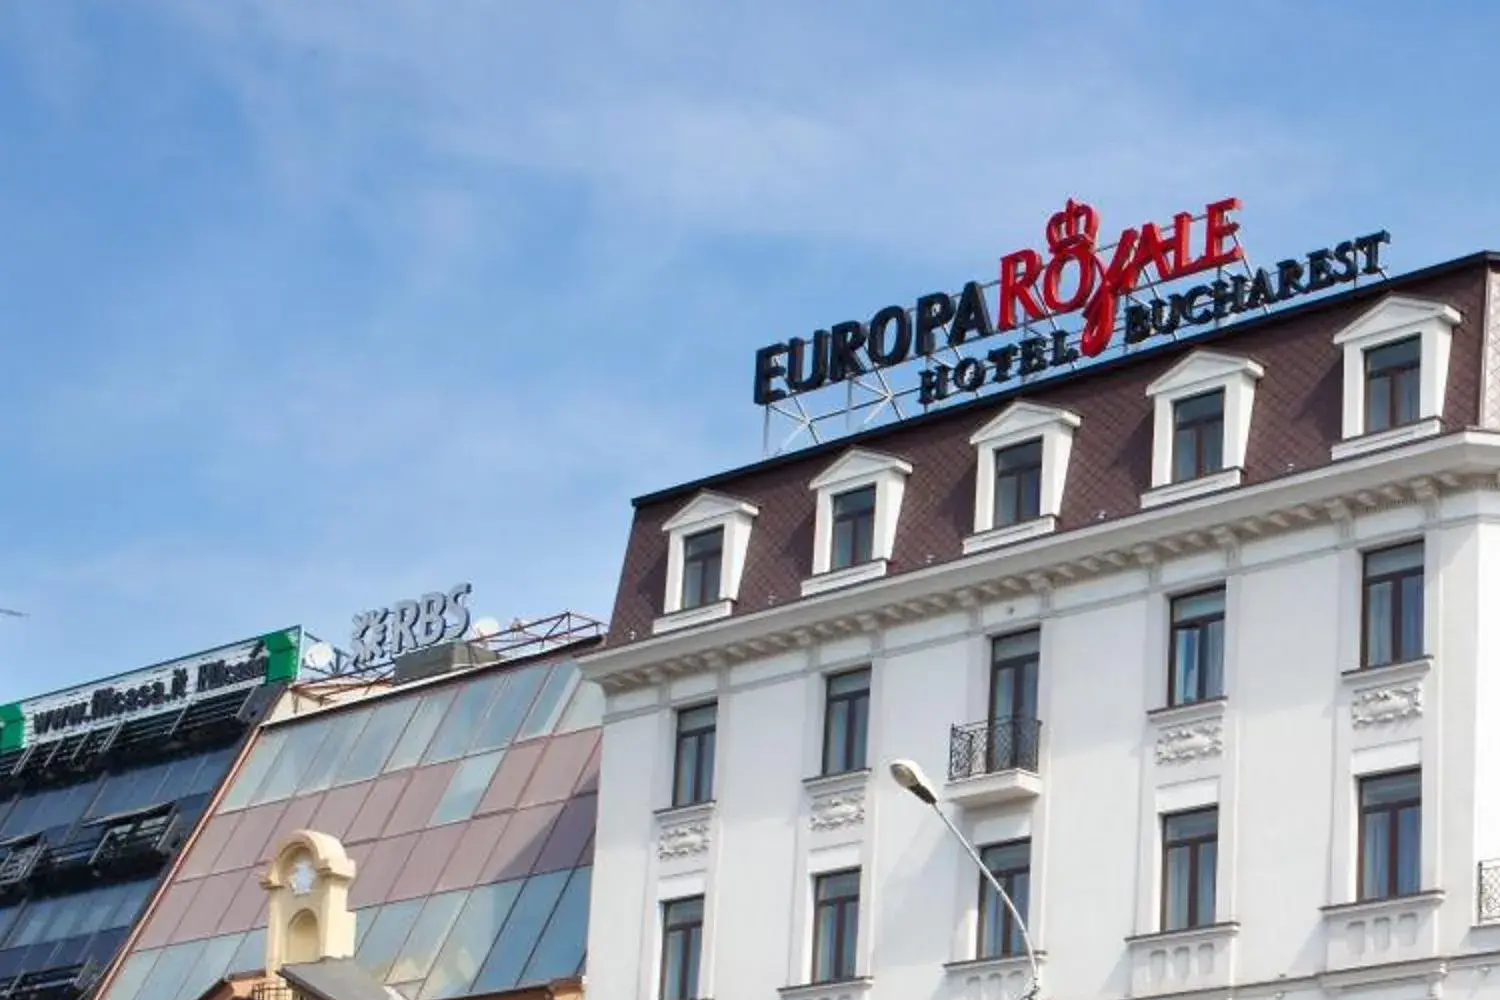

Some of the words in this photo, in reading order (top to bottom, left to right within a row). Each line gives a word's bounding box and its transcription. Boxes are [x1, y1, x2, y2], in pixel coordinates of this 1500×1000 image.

[753, 280, 994, 405] EUROPA
[917, 329, 1080, 404] HOTEL
[1125, 229, 1392, 345] BUCHAREST
